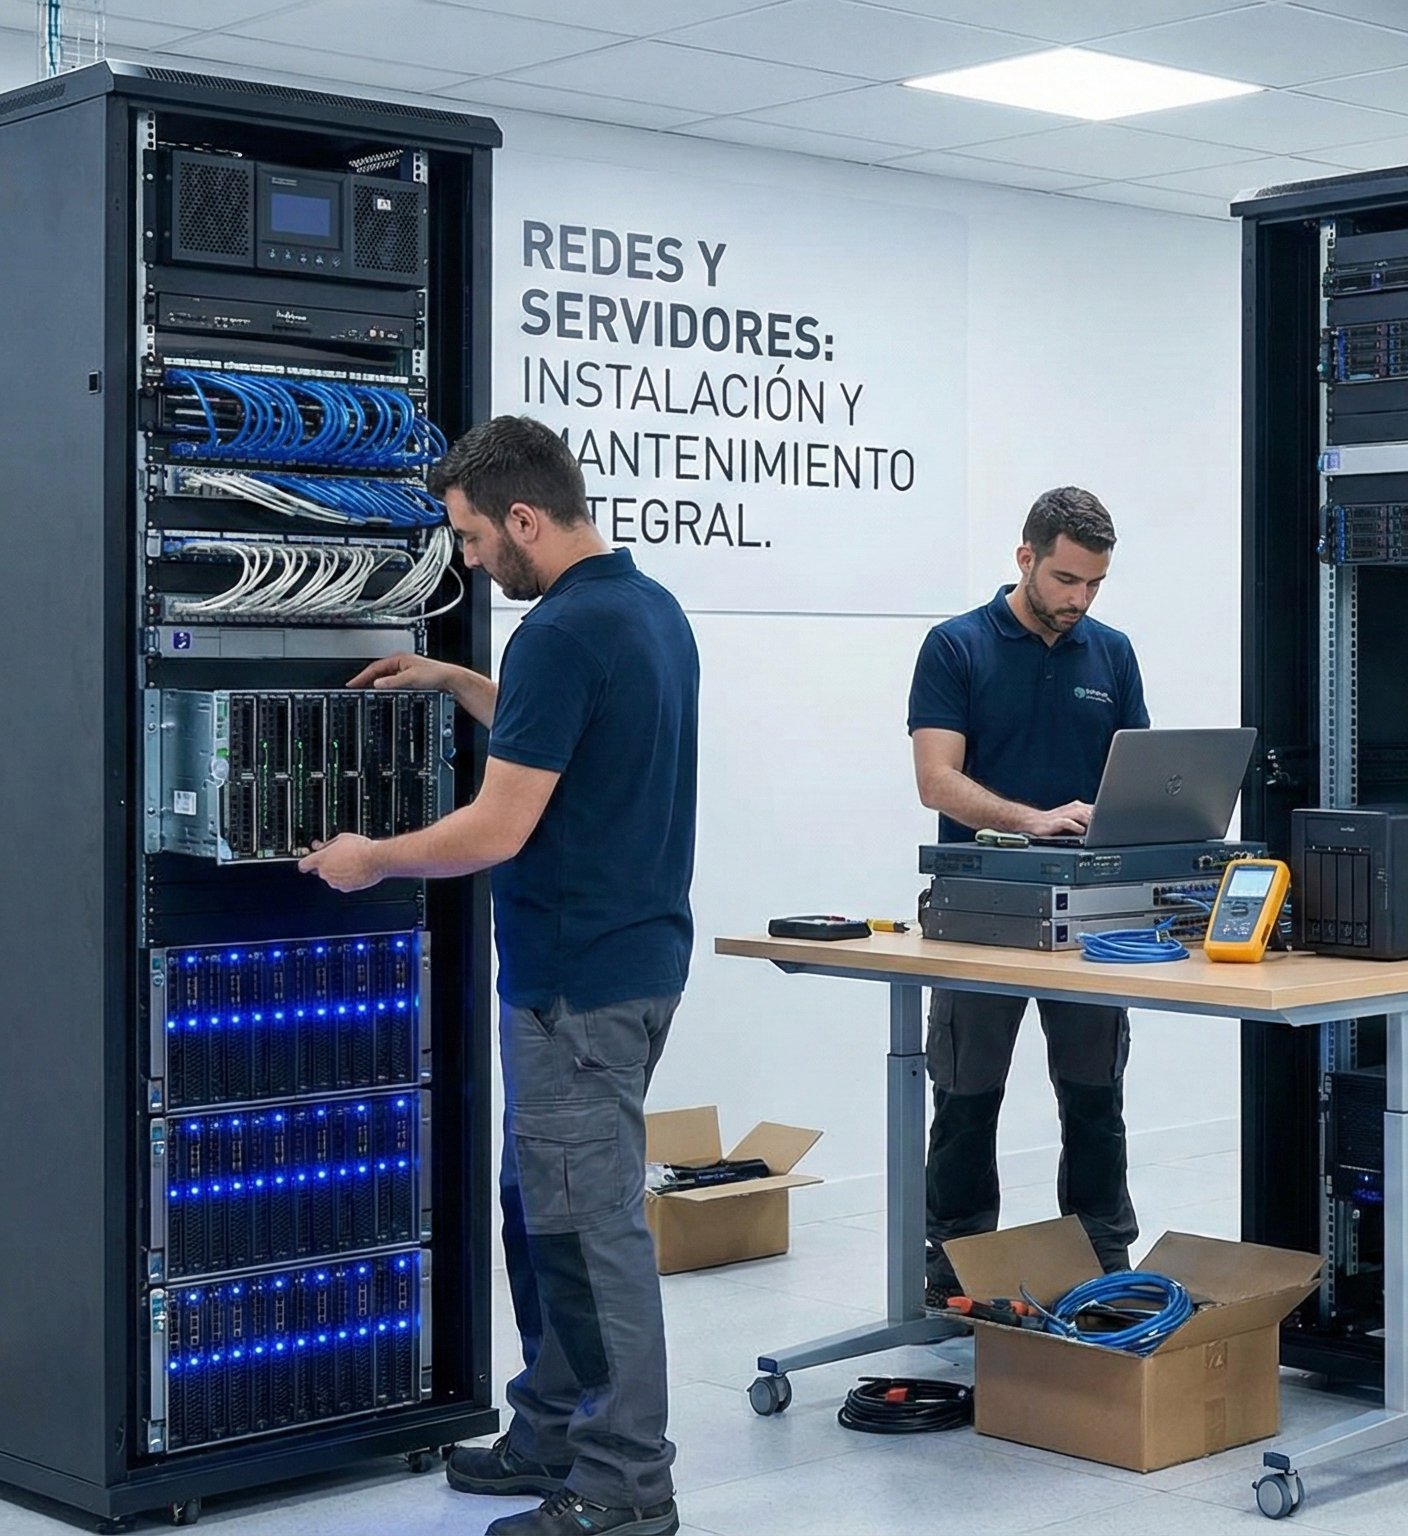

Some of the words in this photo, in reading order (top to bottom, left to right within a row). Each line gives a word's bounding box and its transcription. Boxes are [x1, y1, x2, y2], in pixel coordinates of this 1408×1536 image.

[523, 219, 685, 283] REDES
[697, 240, 728, 287] Y
[520, 288, 834, 362] SERVIDORES:
[524, 356, 825, 424] INSTALACIÓN
[839, 382, 863, 426] Y
[560, 426, 915, 492] ANTENIMIENTO
[586, 496, 772, 548] TEGRAL.
